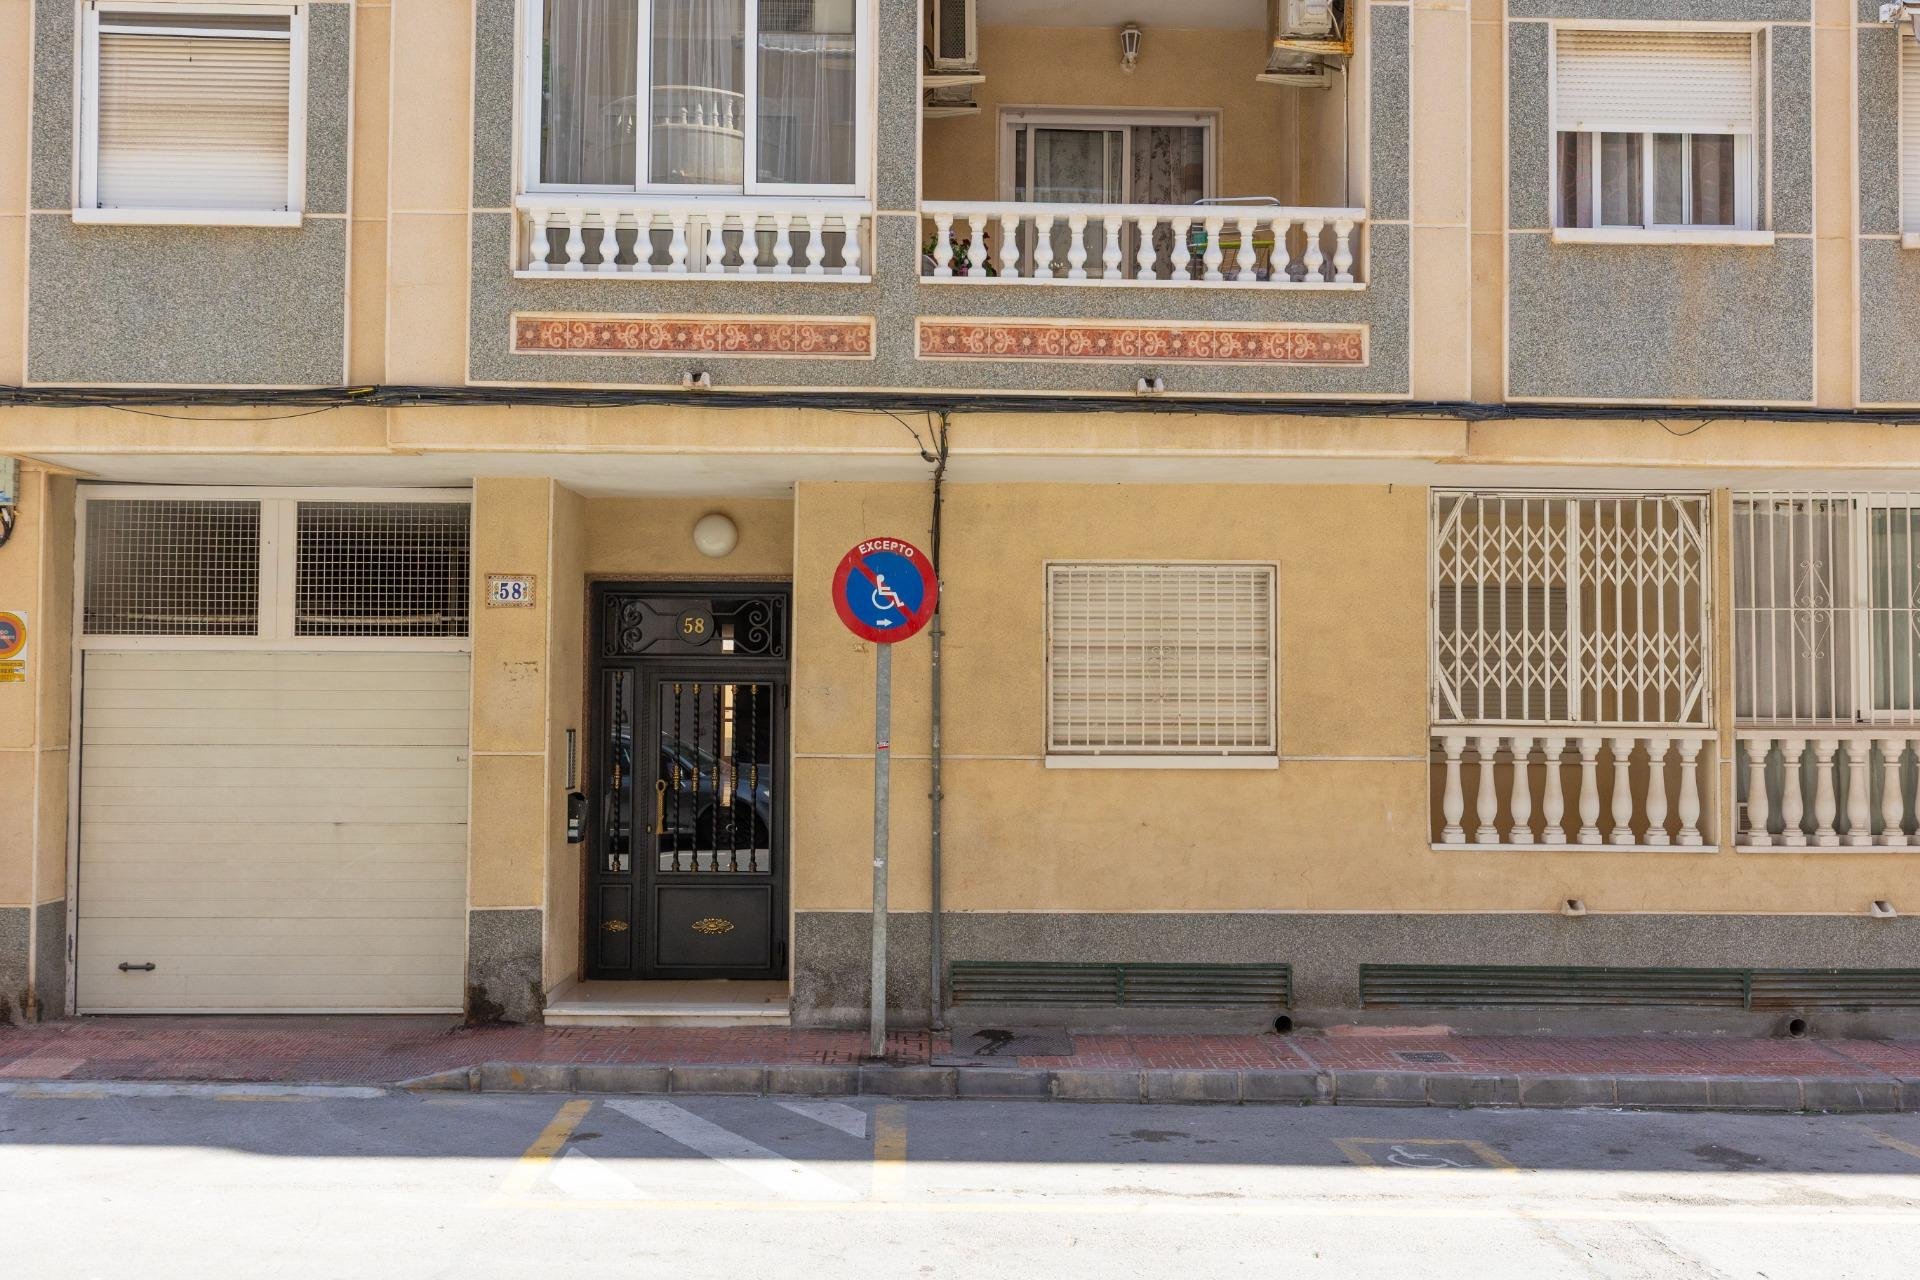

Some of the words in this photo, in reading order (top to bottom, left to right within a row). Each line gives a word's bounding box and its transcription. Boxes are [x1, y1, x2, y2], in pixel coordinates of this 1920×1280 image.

[859, 541, 914, 558] EXCEPTO
[500, 583, 521, 599] 58
[683, 617, 704, 634] 58
